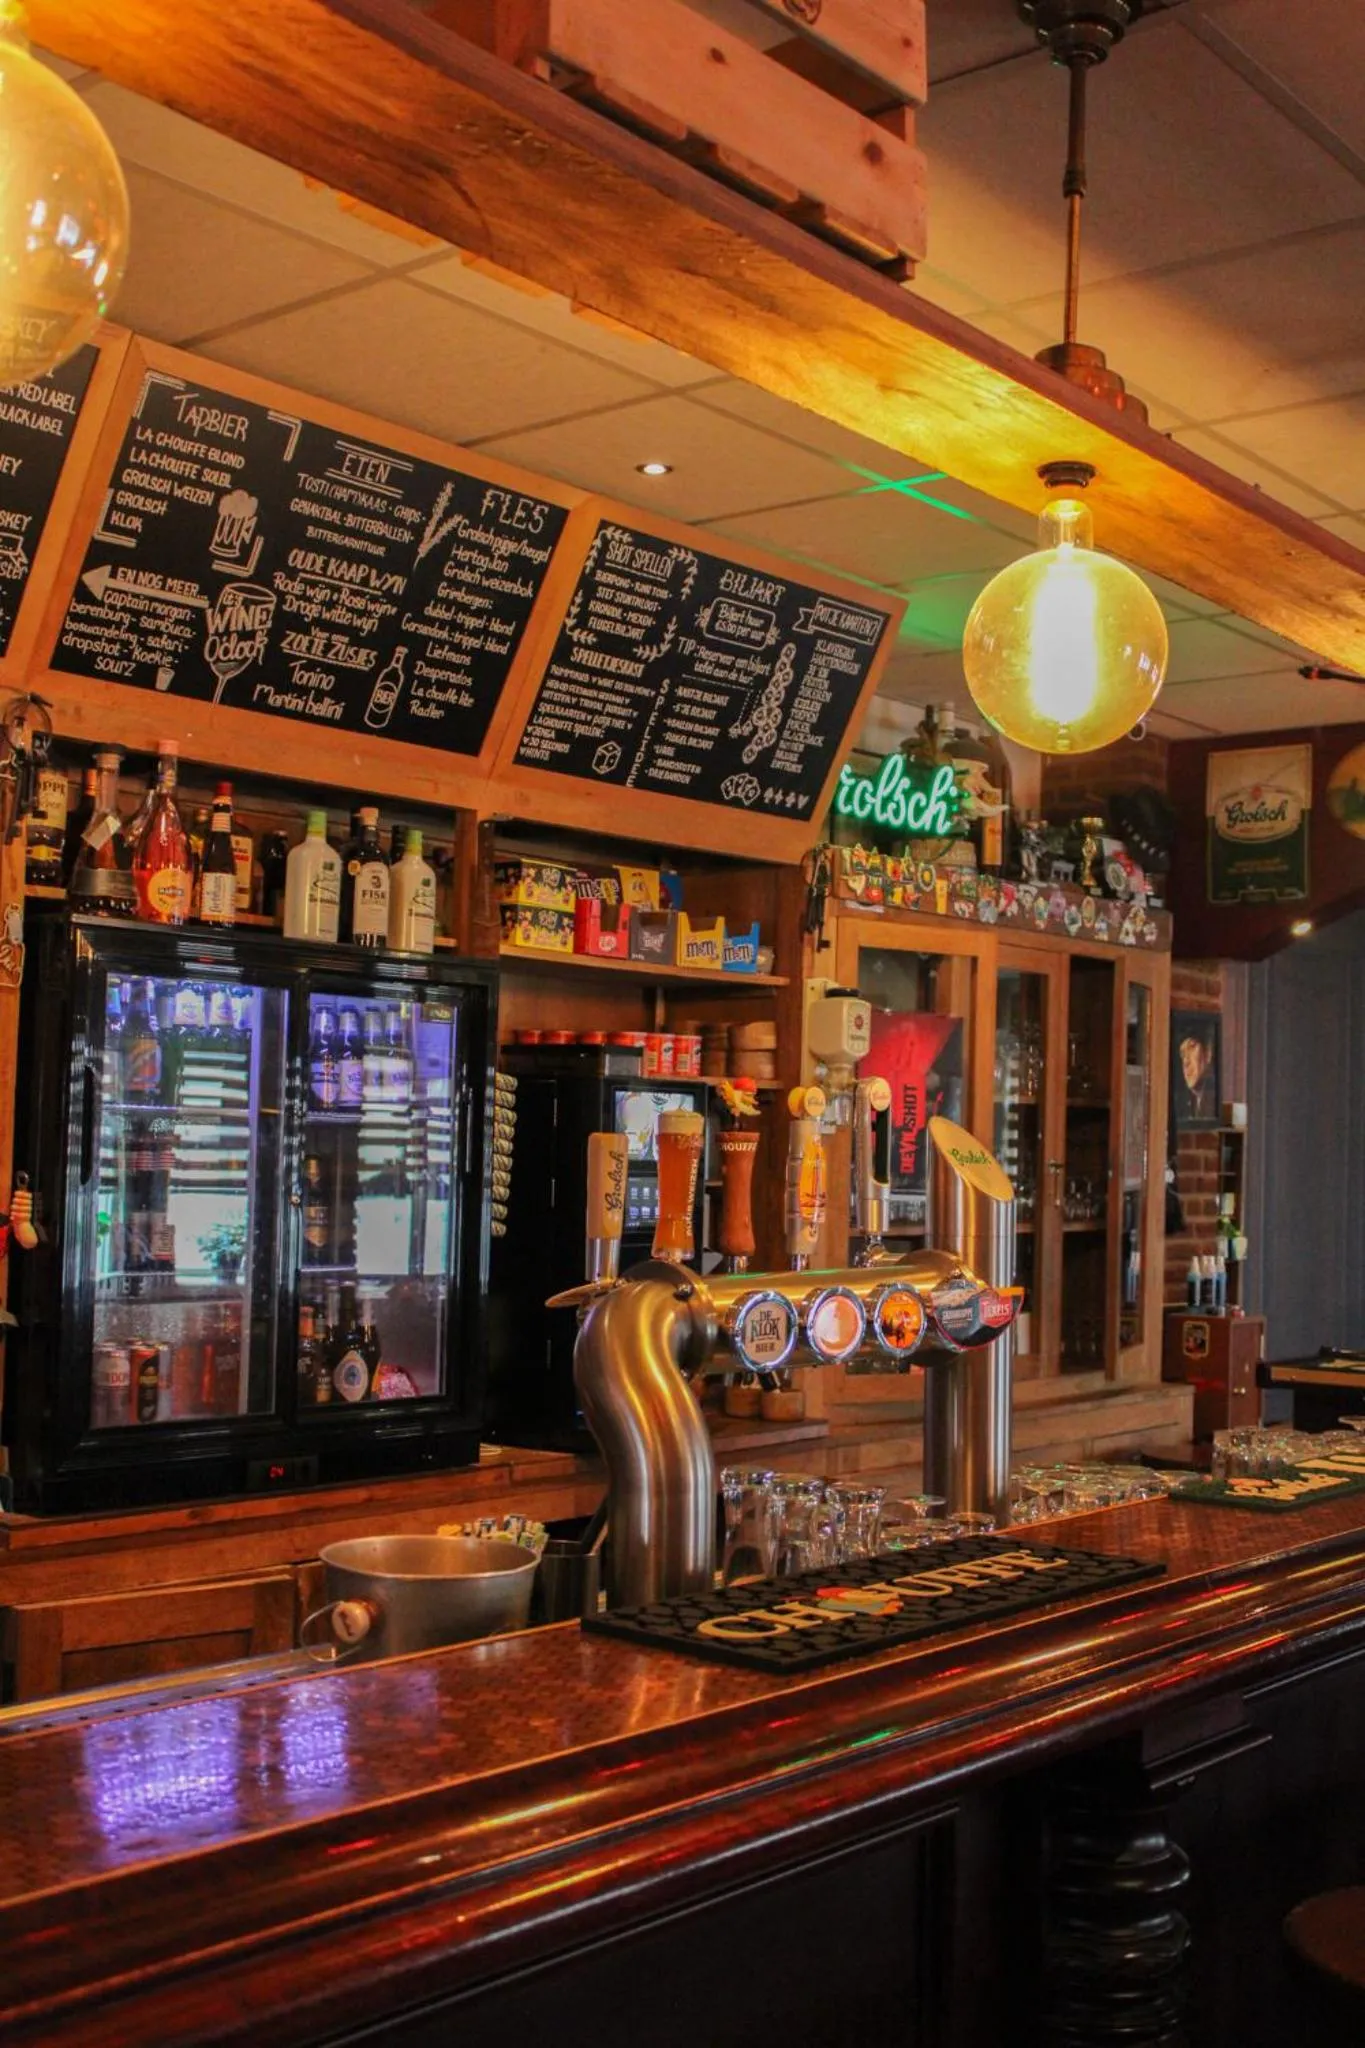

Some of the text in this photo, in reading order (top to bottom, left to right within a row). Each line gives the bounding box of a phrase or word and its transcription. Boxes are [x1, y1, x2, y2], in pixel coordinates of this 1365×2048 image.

[18, 381, 42, 401] RED
[42, 387, 76, 414] LABEL
[31, 413, 64, 436] LABEL
[173, 393, 249, 442] TAPBIER
[130, 447, 148, 465] LA
[149, 452, 201, 479] CHOUFFE
[136, 426, 245, 469] LA CHOUFFE BLOND
[342, 453, 392, 485] ETEN
[116, 490, 169, 516] GROLSCH
[122, 468, 215, 506] GROLSCH WEIZEN
[297, 472, 330, 494] TOSTI
[393, 503, 422, 525] CHIPS
[110, 510, 143, 532] KLOK
[481, 489, 549, 534] FLES
[287, 549, 327, 574] OUDE
[327, 557, 369, 584] KAAP
[443, 561, 481, 584] Grolsch
[451, 544, 510, 573] Hertog Jan
[606, 540, 676, 579] SHOT SPELLEN
[117, 567, 133, 582] EN
[138, 570, 164, 588] NOG
[273, 571, 305, 595] Rode
[719, 568, 787, 607] BILJART
[103, 588, 149, 612] captain
[282, 595, 321, 622] Droge
[321, 606, 352, 625] witte
[280, 630, 379, 668] ZOETE ZUSJES
[289, 659, 336, 691] Tonino
[253, 684, 347, 720] Martini bellini
[838, 754, 952, 834] rolsch
[1224, 799, 1289, 829] Grolsch
[604, 1149, 626, 1212] Grolsch
[750, 1317, 780, 1343] KLOK
[760, 1310, 773, 1321] DE
[697, 1549, 1071, 1638] CHUFFE
